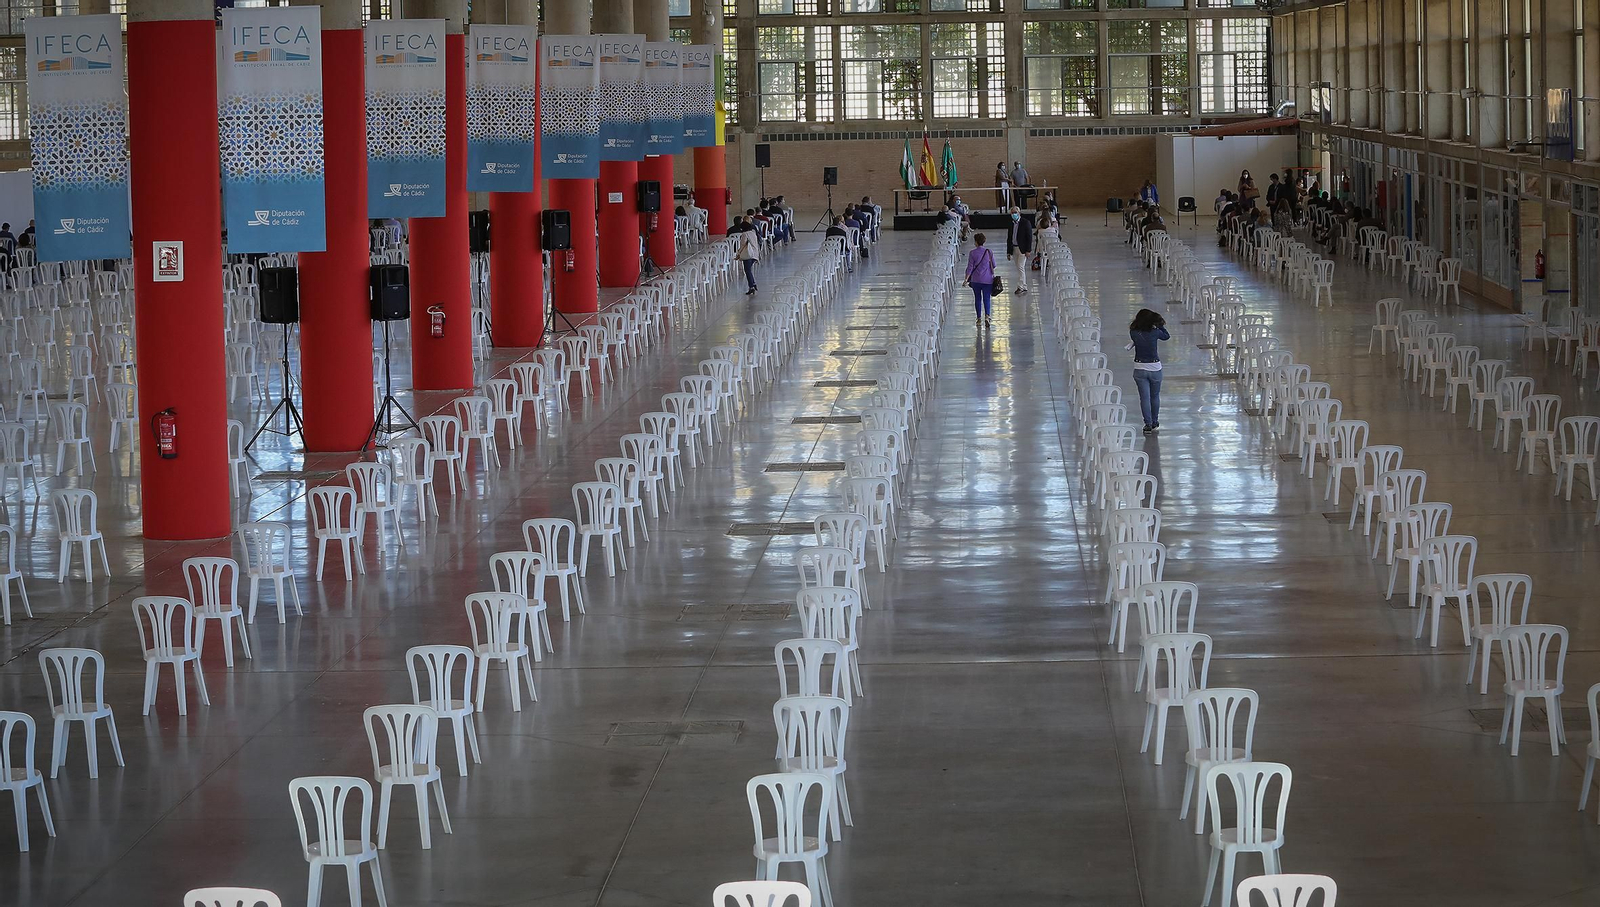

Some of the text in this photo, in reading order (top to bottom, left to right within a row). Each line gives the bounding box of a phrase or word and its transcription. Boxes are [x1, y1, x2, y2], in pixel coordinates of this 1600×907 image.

[233, 26, 310, 45] IFECA
[36, 34, 111, 54] IFECA
[375, 34, 437, 51] IFECA
[476, 37, 529, 51] IFECA
[547, 45, 595, 57] IFECA
[600, 43, 641, 54] IFECA
[645, 49, 678, 60] FECA
[411, 189, 425, 197] Cádiz
[272, 209, 305, 218] Diputación
[281, 217, 300, 226] Cádiz
